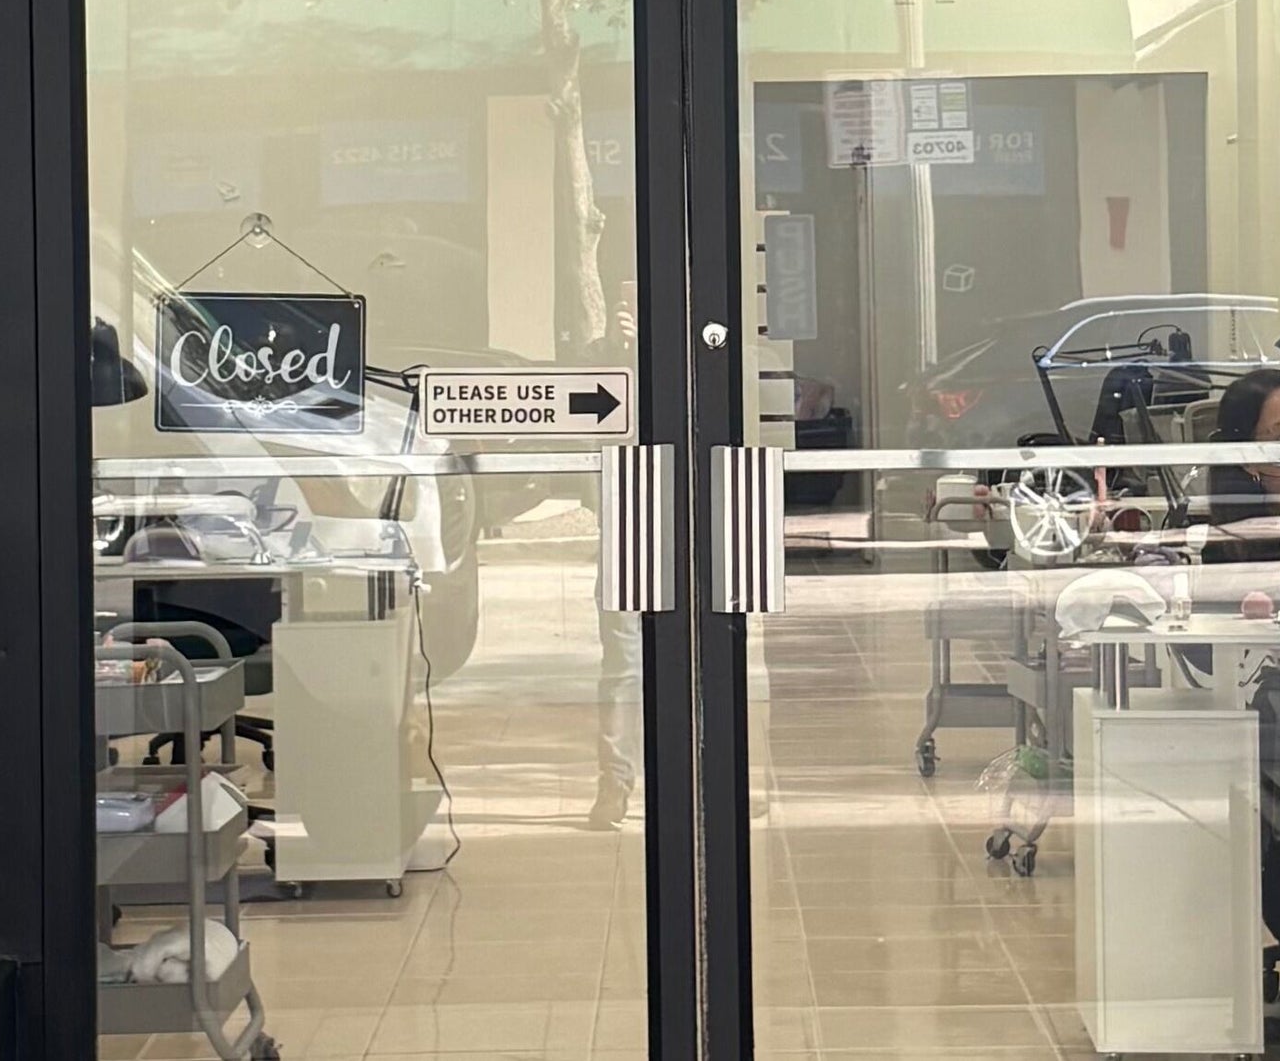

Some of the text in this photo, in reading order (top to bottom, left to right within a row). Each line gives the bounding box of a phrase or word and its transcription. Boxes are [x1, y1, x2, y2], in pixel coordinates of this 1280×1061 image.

[170, 321, 351, 390] Closed
[434, 386, 554, 400] PLEASE USE
[434, 409, 554, 423] OTHER DOOR
